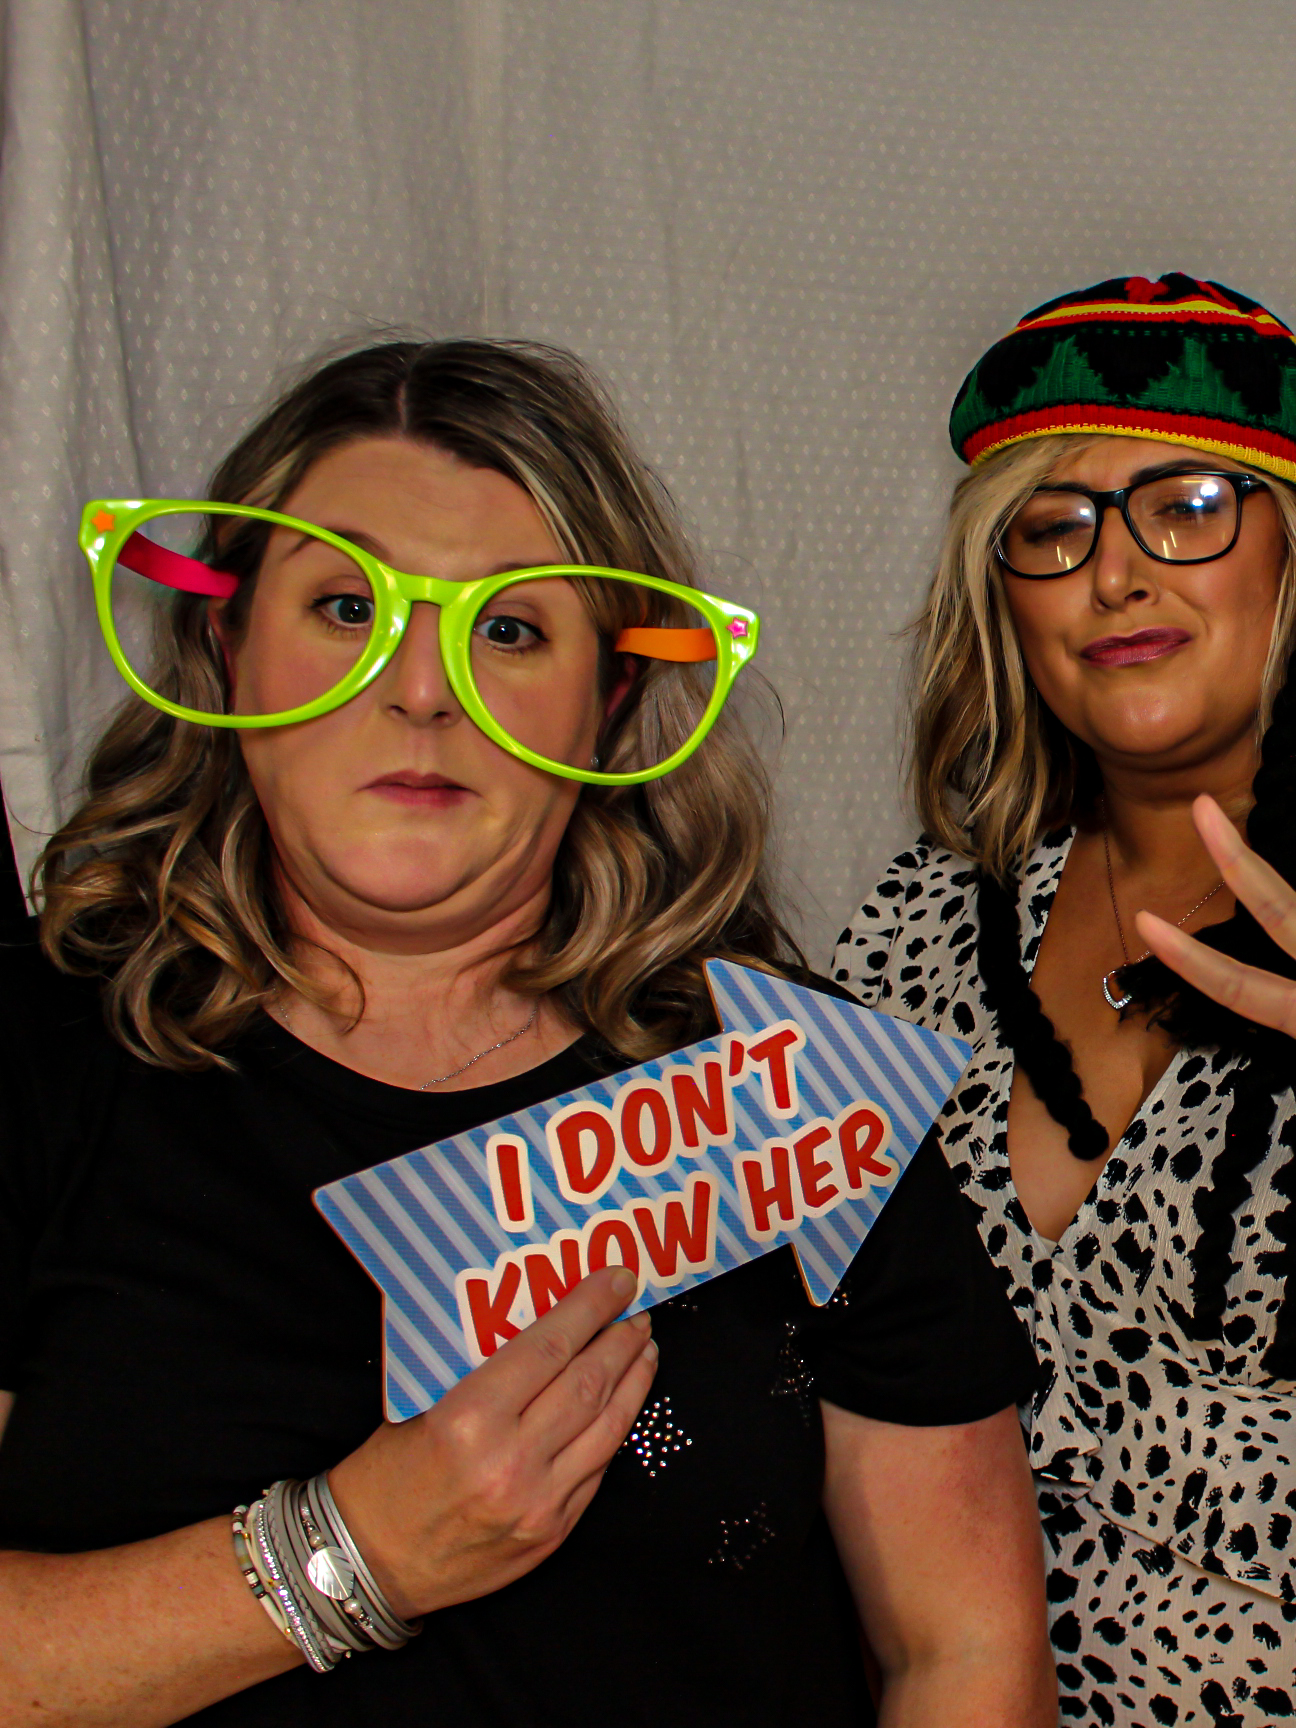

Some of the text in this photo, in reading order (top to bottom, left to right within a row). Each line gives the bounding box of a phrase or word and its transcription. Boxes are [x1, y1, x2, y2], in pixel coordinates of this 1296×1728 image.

[465, 1109, 893, 1358] KNOW HER
[495, 1028, 799, 1222] I DON'T
